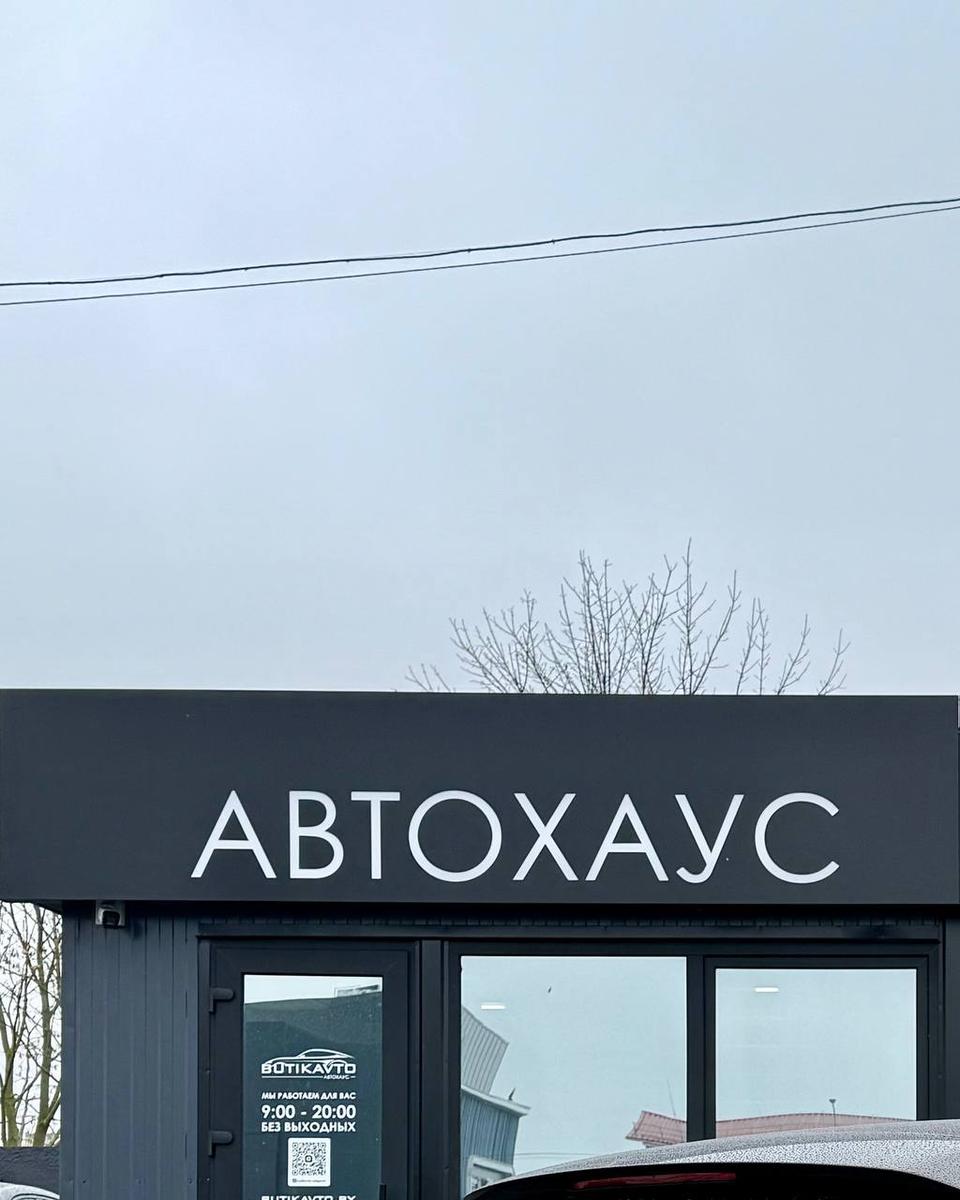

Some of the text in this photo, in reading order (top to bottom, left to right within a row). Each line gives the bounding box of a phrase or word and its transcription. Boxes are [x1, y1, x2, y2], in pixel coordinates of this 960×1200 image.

[191, 789, 840, 884] АВТОХАУС
[261, 1063, 356, 1074] BUTIKAVTO
[261, 1092, 356, 1100] МЫ РАБОТАЕМ ДЛЯ ВАС
[261, 1105, 295, 1119] 9:00
[312, 1105, 356, 1119] 20:00
[261, 1122, 356, 1133] БЕЗ ВЫХОДНЫХ
